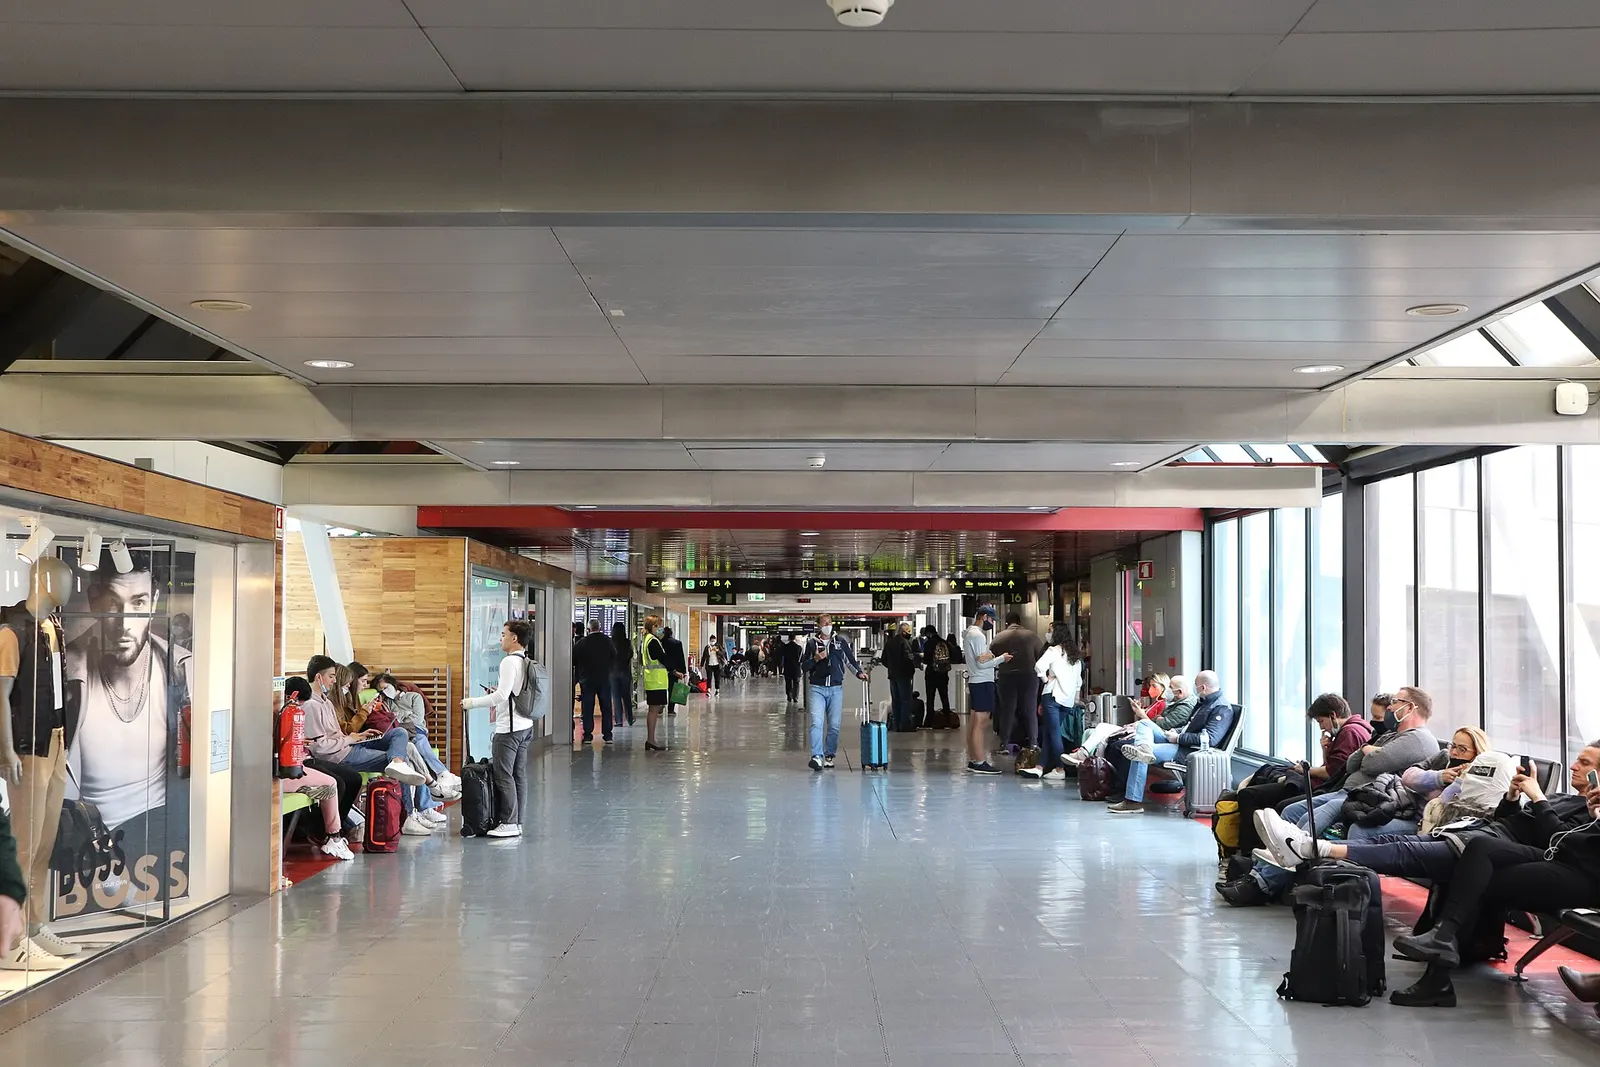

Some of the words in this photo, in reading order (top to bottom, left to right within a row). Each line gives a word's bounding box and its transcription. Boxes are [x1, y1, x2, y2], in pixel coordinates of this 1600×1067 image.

[1011, 593, 1022, 603] 16
[874, 601, 891, 610] 16A
[114, 879, 128, 887] OWN
